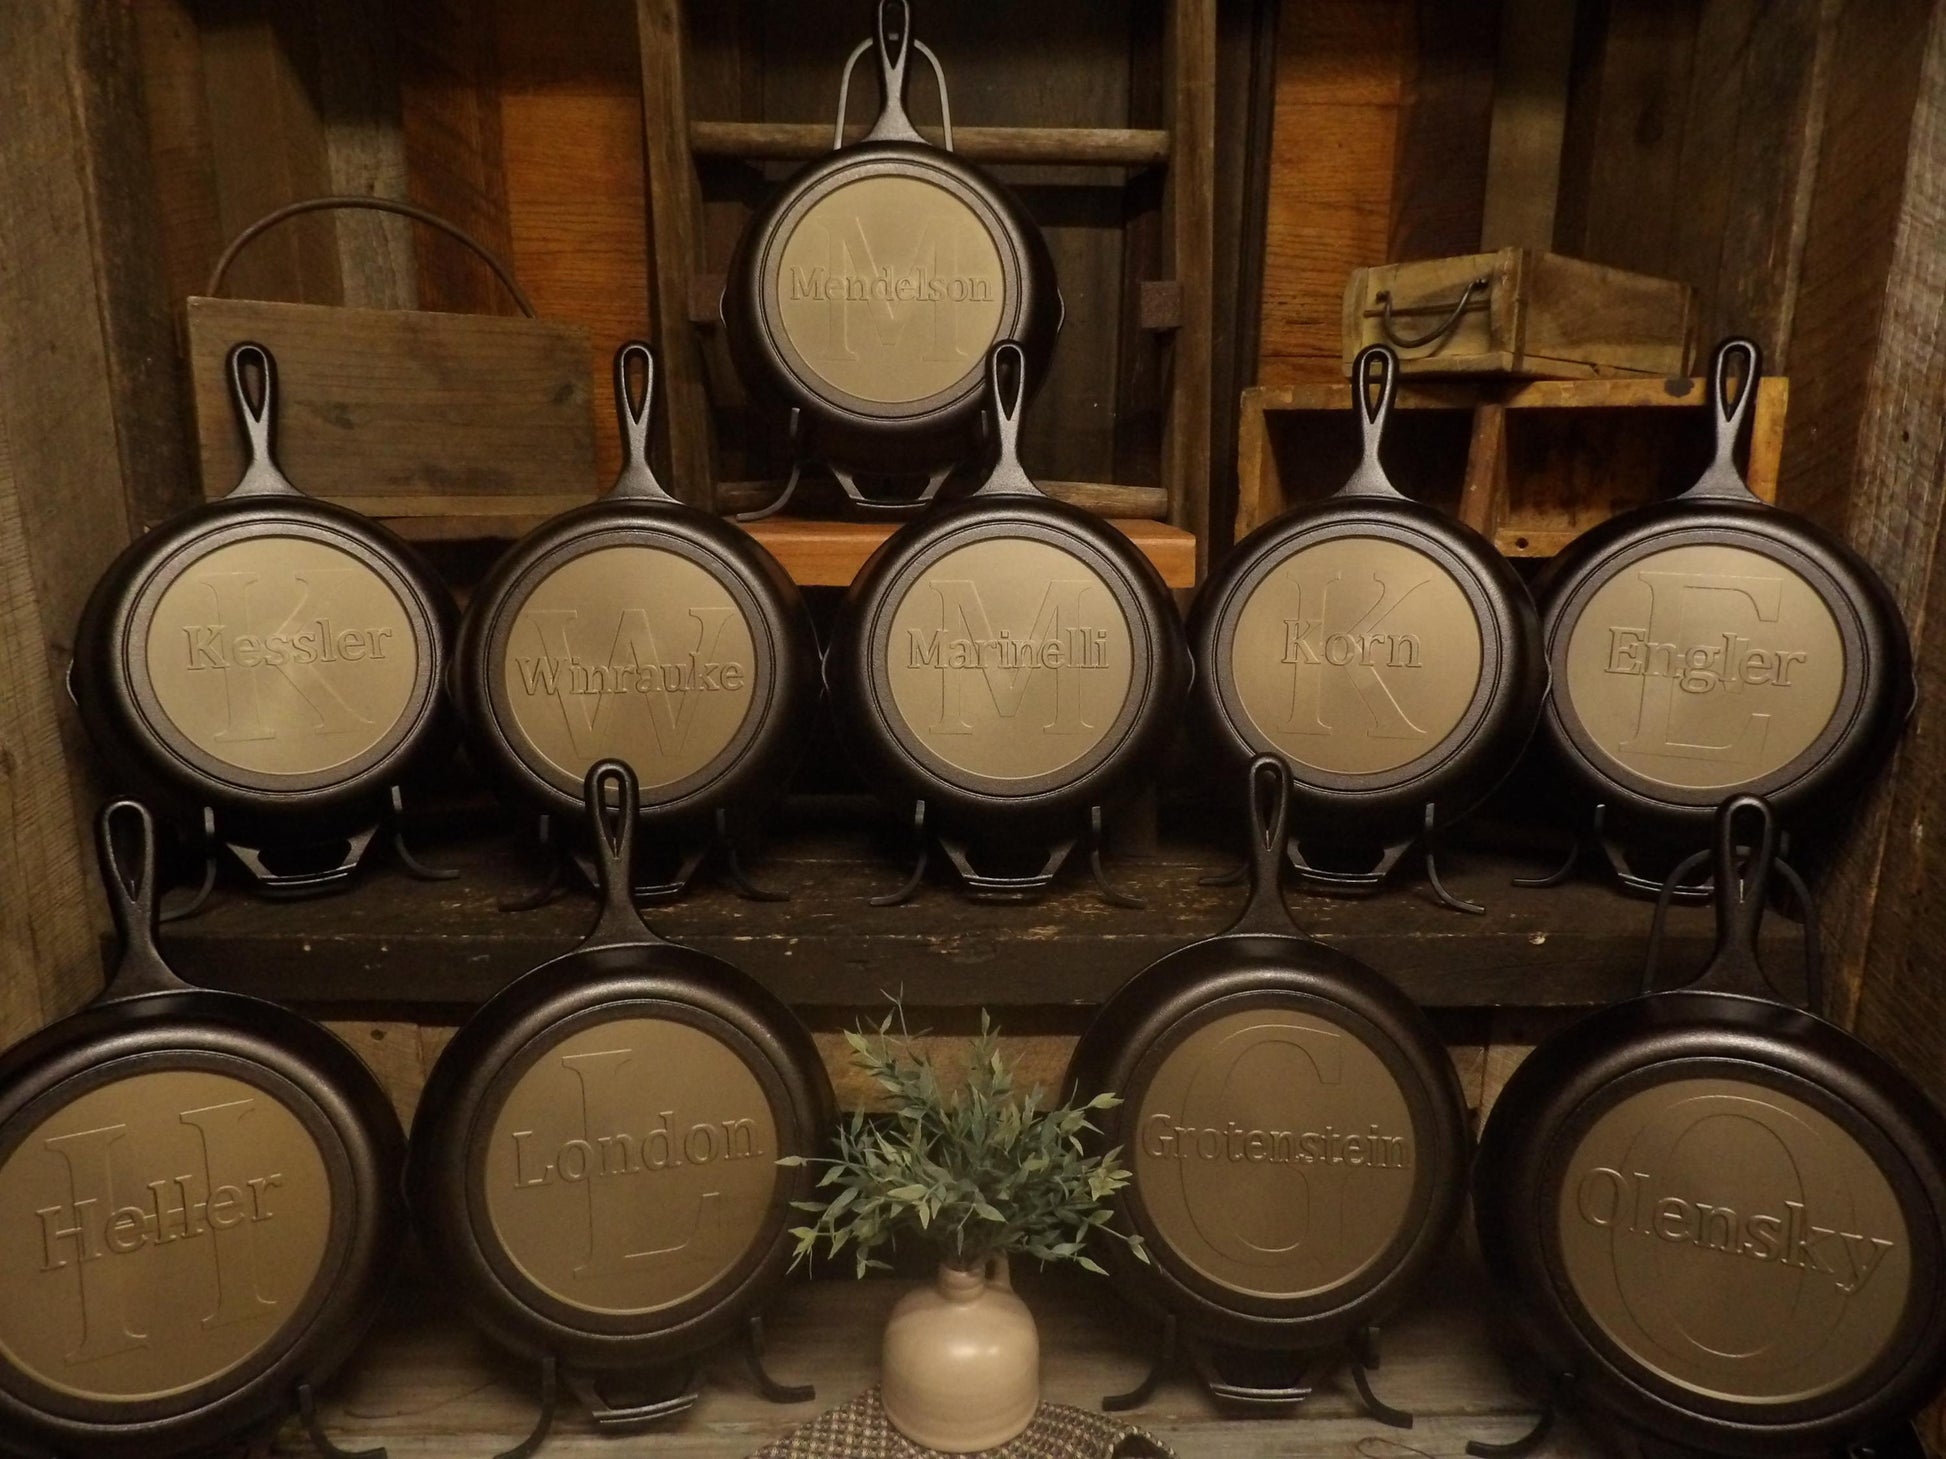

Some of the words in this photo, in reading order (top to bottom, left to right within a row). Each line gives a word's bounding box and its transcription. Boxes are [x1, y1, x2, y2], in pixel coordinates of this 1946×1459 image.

[789, 264, 994, 302] Mendelson
[182, 617, 393, 671] Kessler
[907, 627, 1110, 670] Marinelli
[1281, 619, 1423, 669] Korn
[1604, 626, 1808, 694] Engler
[515, 651, 745, 696] Winrauke
[511, 1110, 764, 1188] London
[1142, 1113, 1411, 1168] Grotenstein
[35, 1173, 282, 1271] Heller
[1577, 1167, 1895, 1296] Olensky
